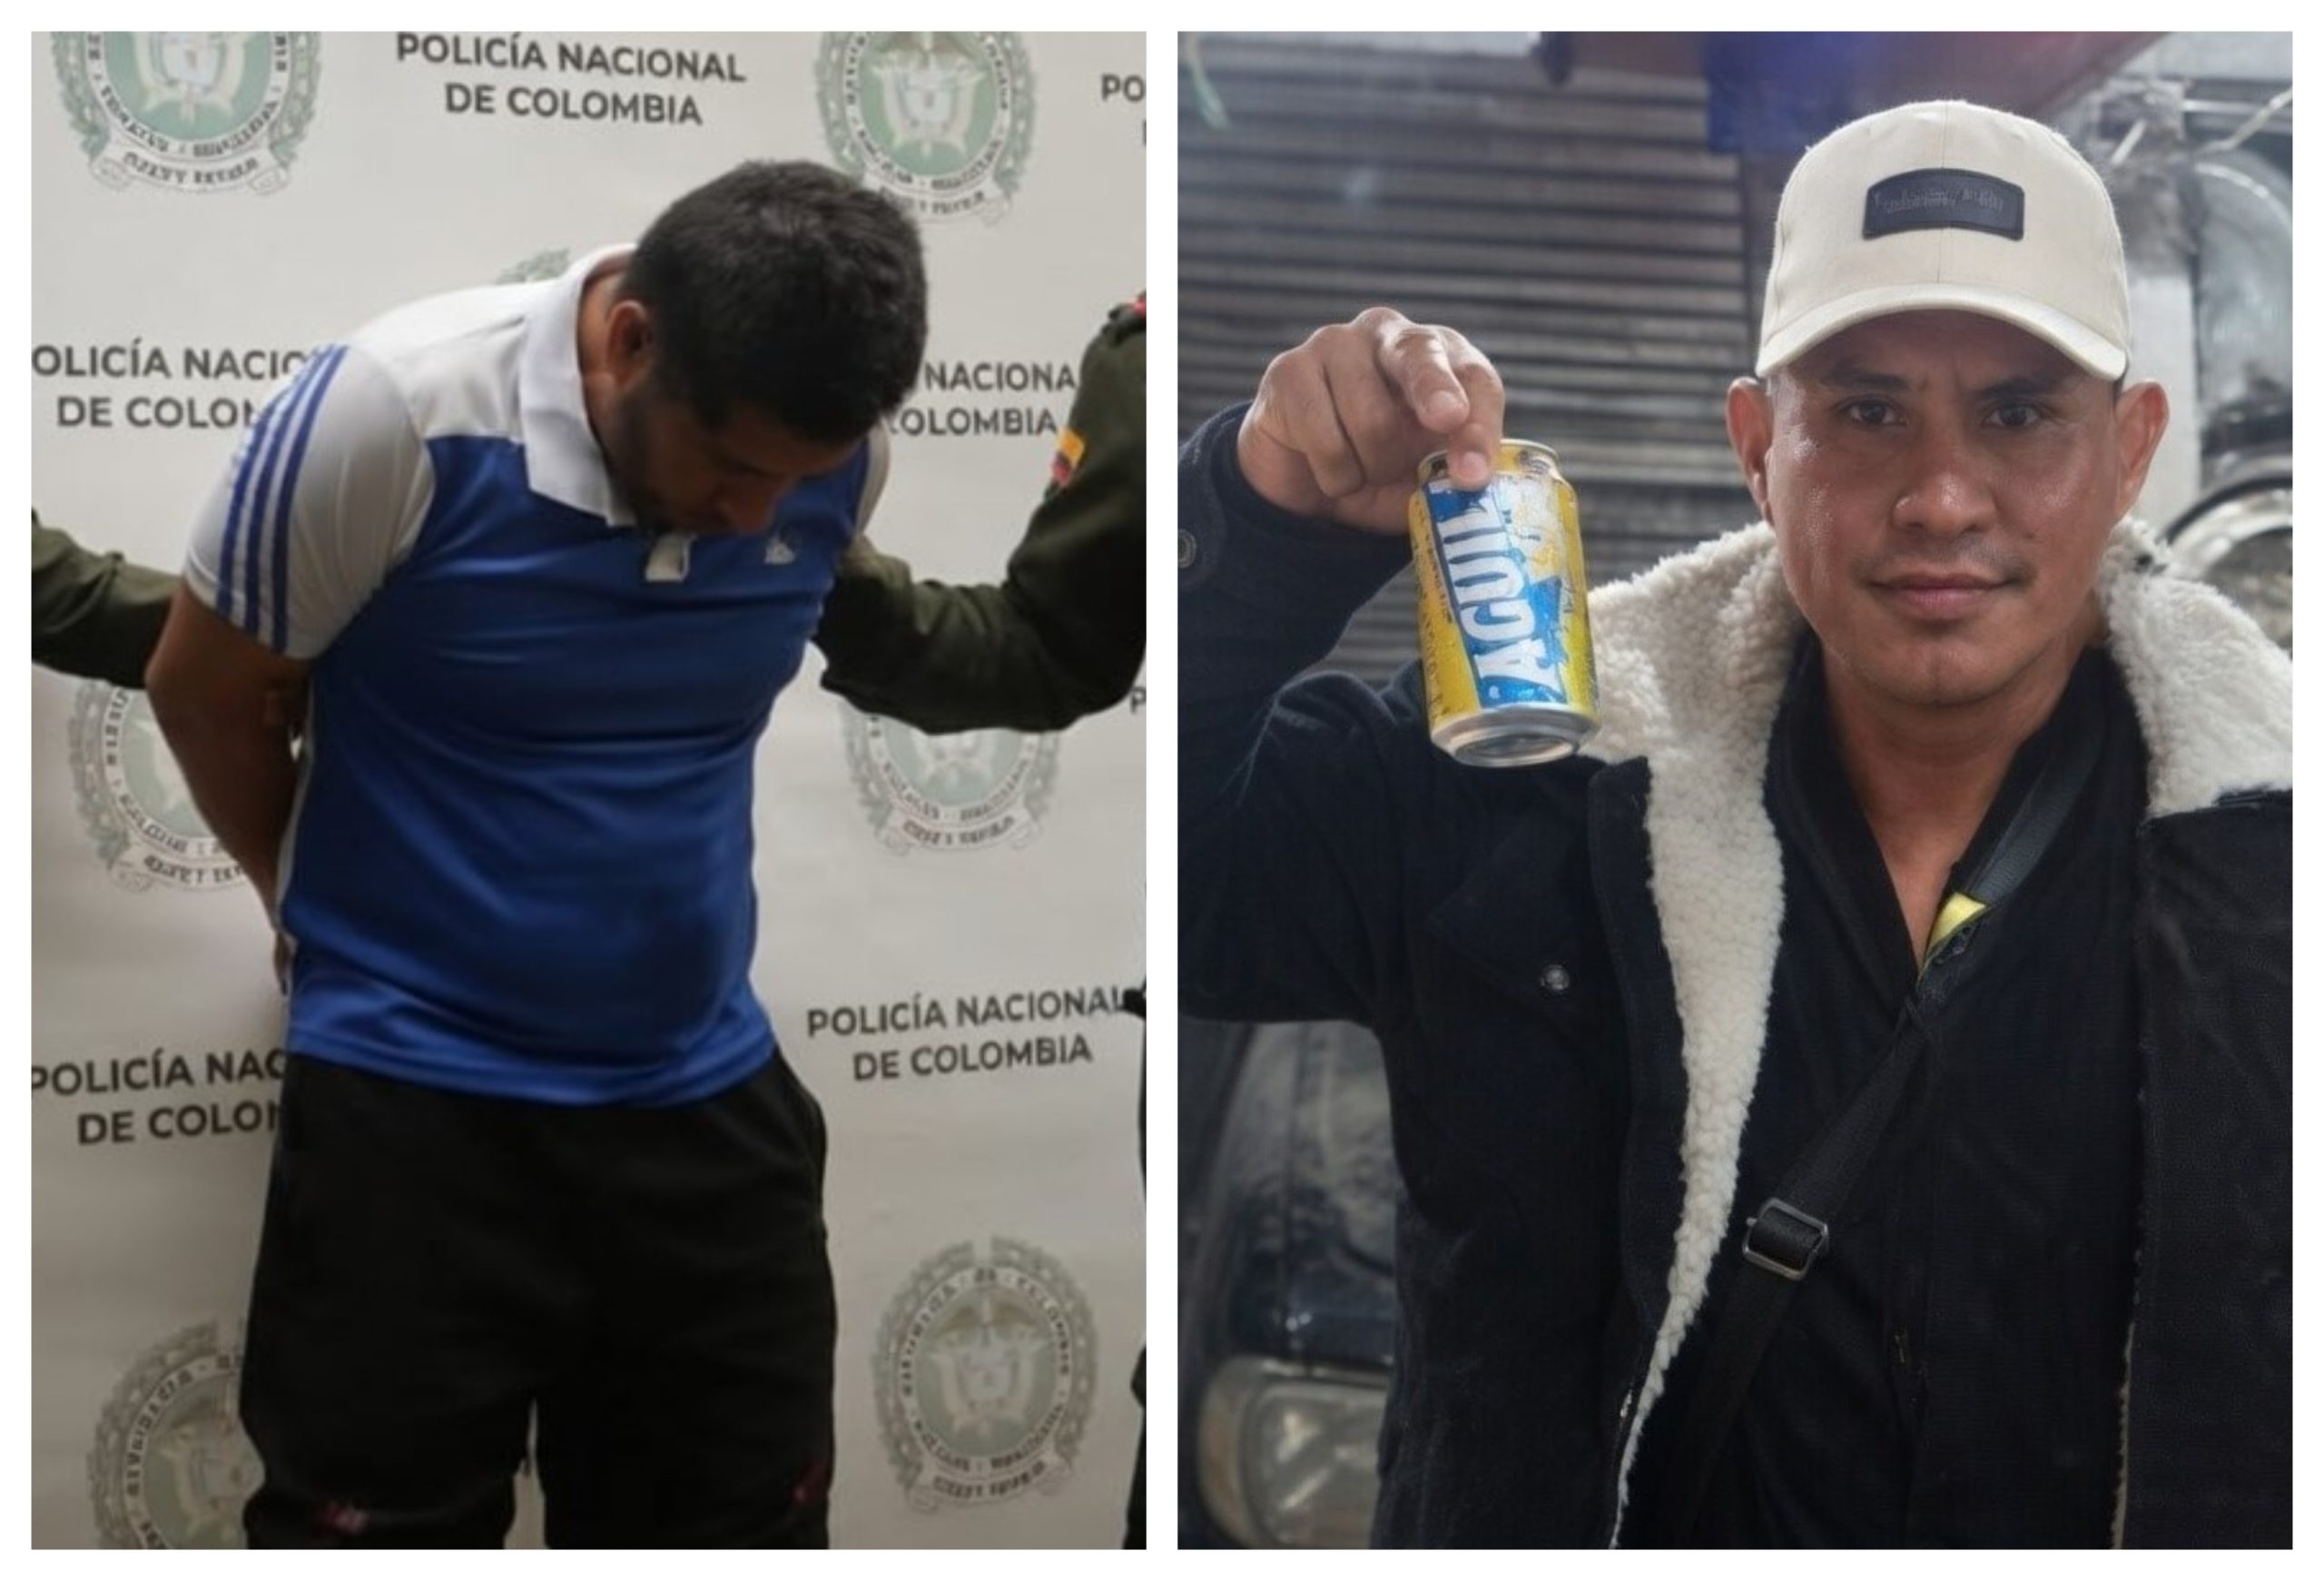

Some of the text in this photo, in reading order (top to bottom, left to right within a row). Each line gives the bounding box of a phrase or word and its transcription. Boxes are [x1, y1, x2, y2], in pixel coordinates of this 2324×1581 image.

[397, 32, 747, 83] POLICÍA NACIONAL
[445, 83, 704, 125] DE COLOMBIA
[32, 337, 172, 379] OLICÍA
[924, 361, 1077, 391] NACIONA
[56, 395, 255, 429] DE COLO
[889, 407, 1058, 436] OLOMBIA
[1429, 479, 1567, 705] AGUIL
[807, 984, 1126, 1037] POLICÍA NACIONAL
[853, 1033, 1094, 1081] DE COLOMBIA
[76, 1099, 281, 1146] DE COLO
